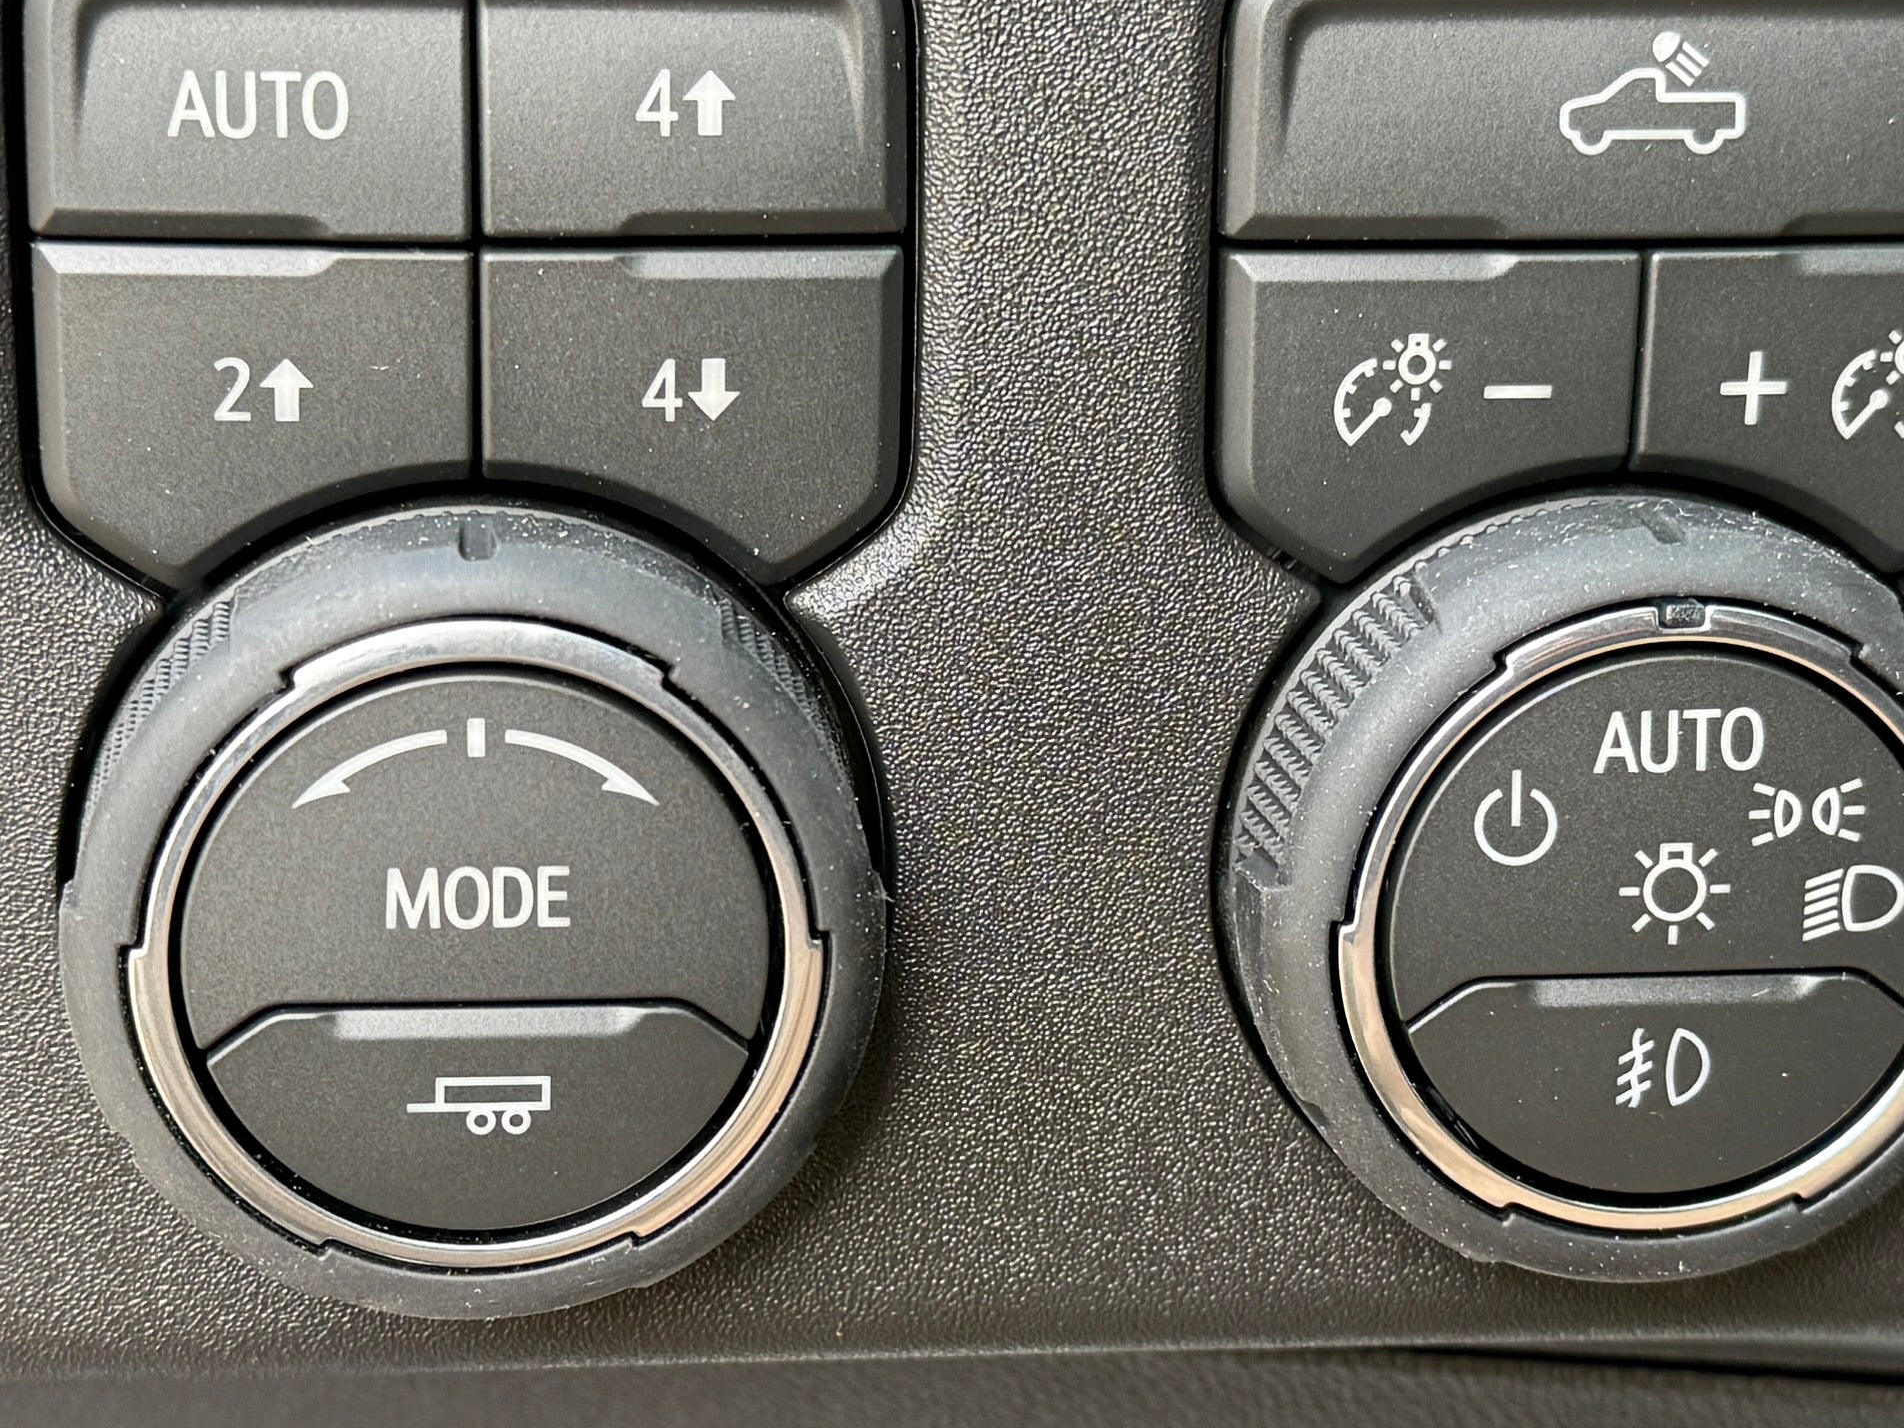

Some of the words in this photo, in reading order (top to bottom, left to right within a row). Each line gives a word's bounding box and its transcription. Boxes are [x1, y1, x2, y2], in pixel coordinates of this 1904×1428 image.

[167, 68, 350, 141] AUTO
[634, 67, 680, 138] 4
[212, 355, 253, 423] 2
[640, 357, 684, 423] 4
[1592, 705, 1766, 775] AUTO
[384, 864, 572, 931] MODE
